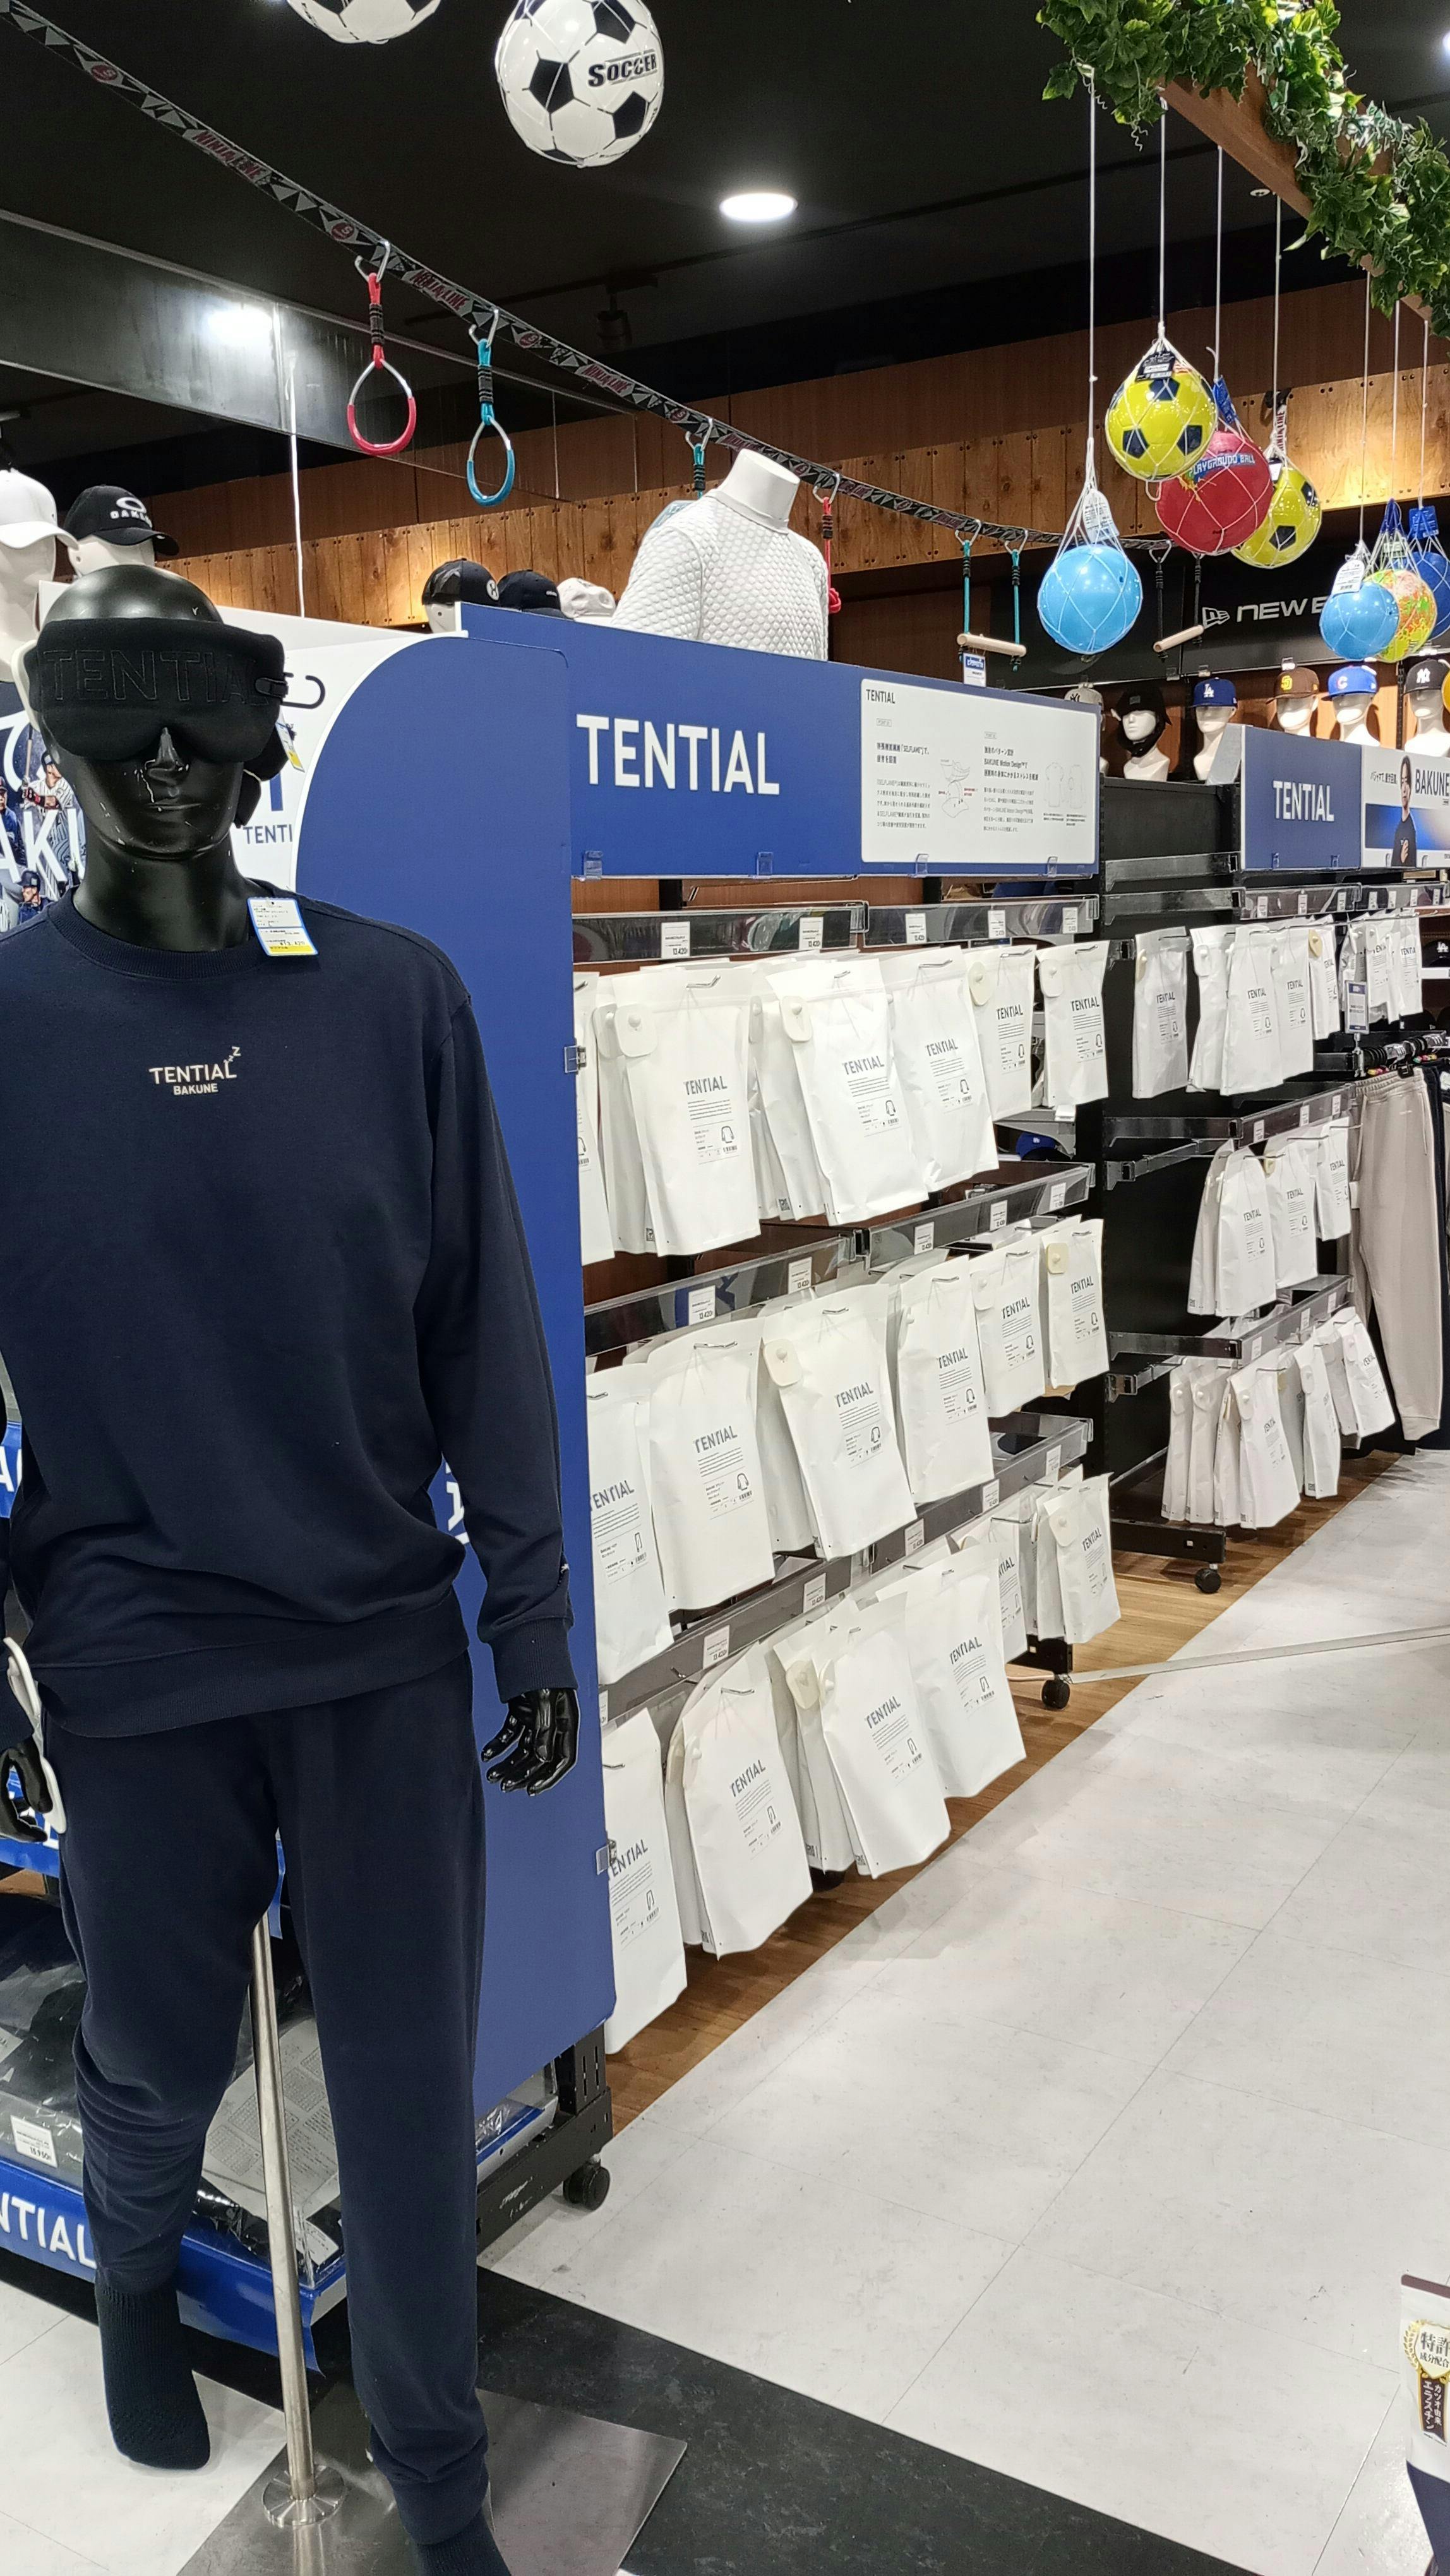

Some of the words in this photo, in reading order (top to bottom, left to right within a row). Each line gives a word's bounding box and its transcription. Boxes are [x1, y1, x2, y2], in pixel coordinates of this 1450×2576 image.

[588, 53, 657, 87] SOCCER
[1240, 454, 1255, 464] BALL
[1236, 598, 1309, 623] NEW
[866, 689, 896, 704] TENTIAL
[576, 713, 780, 796] TENTIAL
[1415, 769, 1450, 797] BAKUNE
[1272, 780, 1334, 822] TENTIAL
[243, 823, 293, 845] TENTI
[1071, 996, 1099, 1011] TENTIAL
[1156, 992, 1176, 1004] TENTIAL
[1247, 988, 1267, 1000] TENTIAL
[996, 1004, 1024, 1020] TENTIAL
[925, 1038, 959, 1057] TENTIAL
[148, 1062, 237, 1085] TENTIAL
[842, 1055, 885, 1075] TENTIAL
[173, 1083, 219, 1095] BAKUNE
[683, 1075, 728, 1095] TENTIAL
[1070, 1275, 1094, 1294] TENTIAL
[1001, 1297, 1031, 1320] TENTIAL
[937, 1347, 969, 1369] TENTIAL
[834, 1382, 874, 1409] TENTIAL
[693, 1426, 738, 1454] TENTIAL
[590, 1480, 635, 1511] ENTIAL
[1082, 1527, 1102, 1552] TENTIAL
[949, 1637, 983, 1666] TENTIAL
[865, 1696, 902, 1730] TENTIAL
[729, 1759, 767, 1798] TENTIAL
[608, 1838, 649, 1880] ENTIAL
[1423, 2381, 1435, 2430] エラスチン
